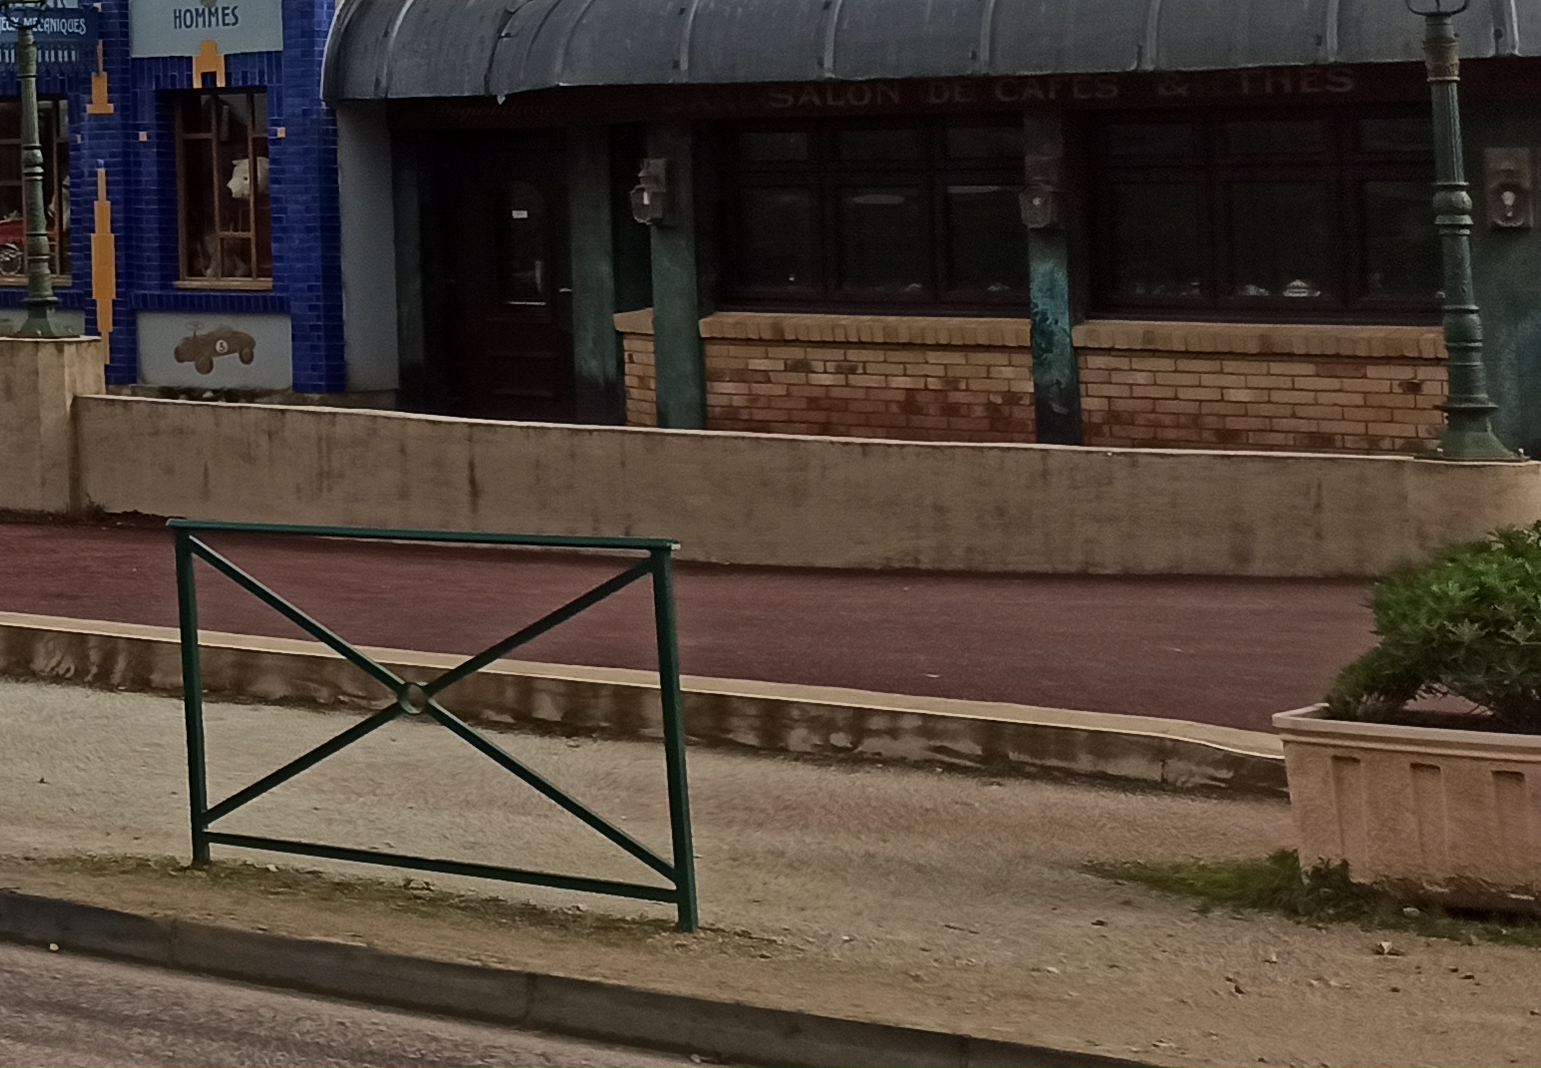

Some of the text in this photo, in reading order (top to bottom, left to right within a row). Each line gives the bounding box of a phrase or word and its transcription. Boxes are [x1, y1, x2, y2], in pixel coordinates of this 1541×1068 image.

[173, 5, 239, 30] HOMMES
[768, 82, 900, 108] SALON
[927, 80, 972, 104] DE
